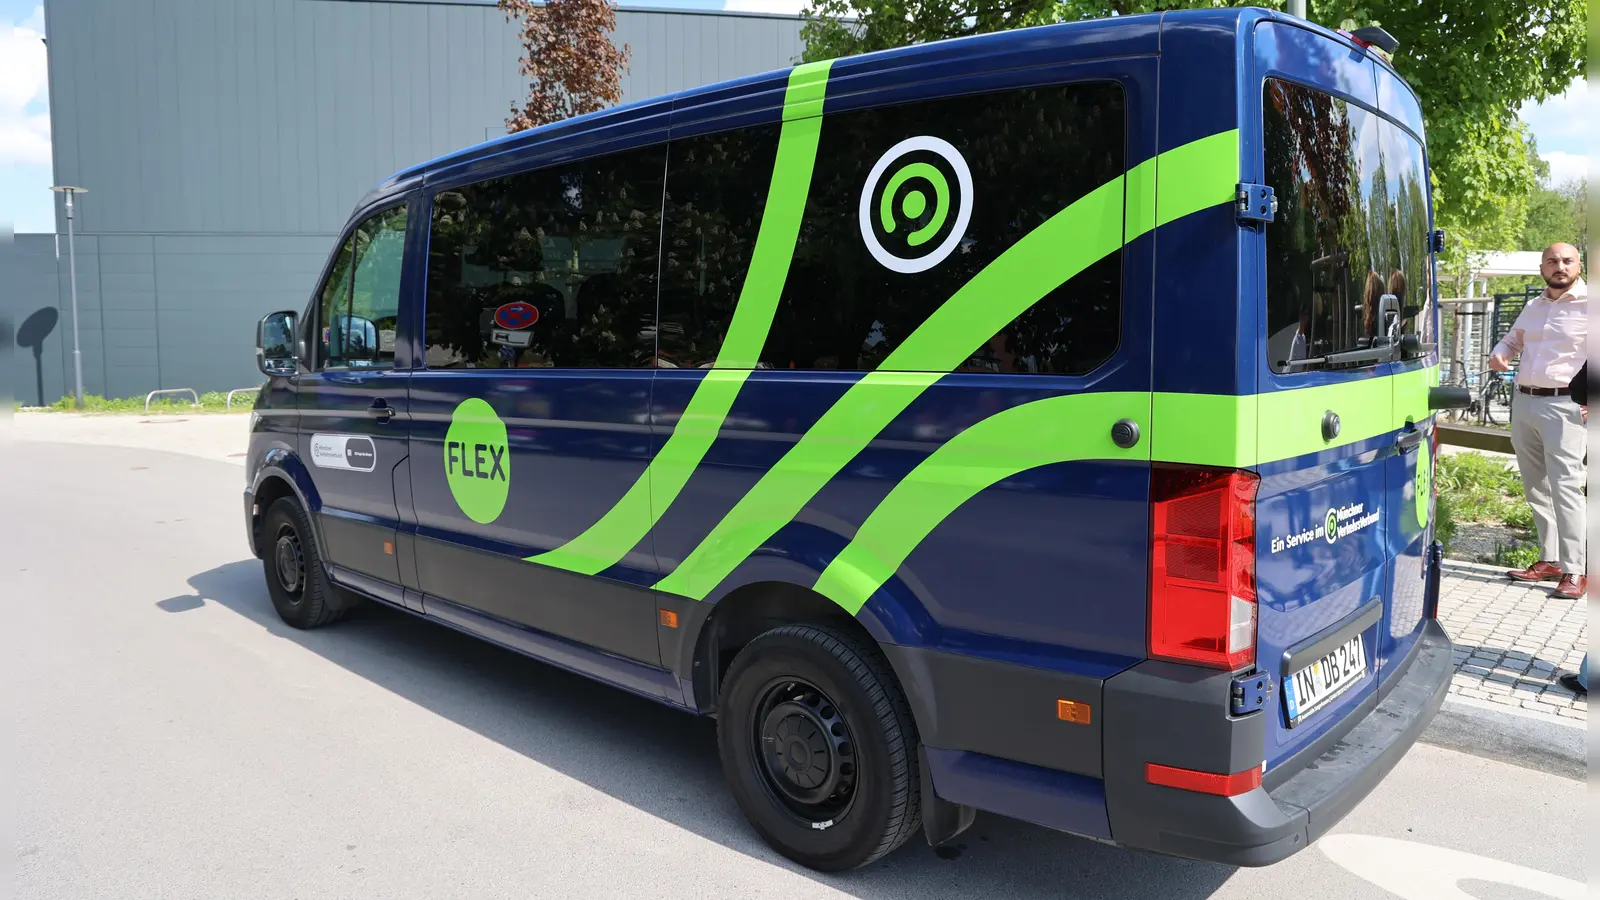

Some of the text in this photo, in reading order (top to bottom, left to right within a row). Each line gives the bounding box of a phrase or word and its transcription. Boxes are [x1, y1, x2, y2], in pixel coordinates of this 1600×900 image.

[448, 441, 506, 482] FLEX
[1271, 523, 1324, 554] Ein Service im
[1296, 666, 1316, 707] IN
[1320, 651, 1340, 690] DB
[1340, 635, 1361, 678] 247
